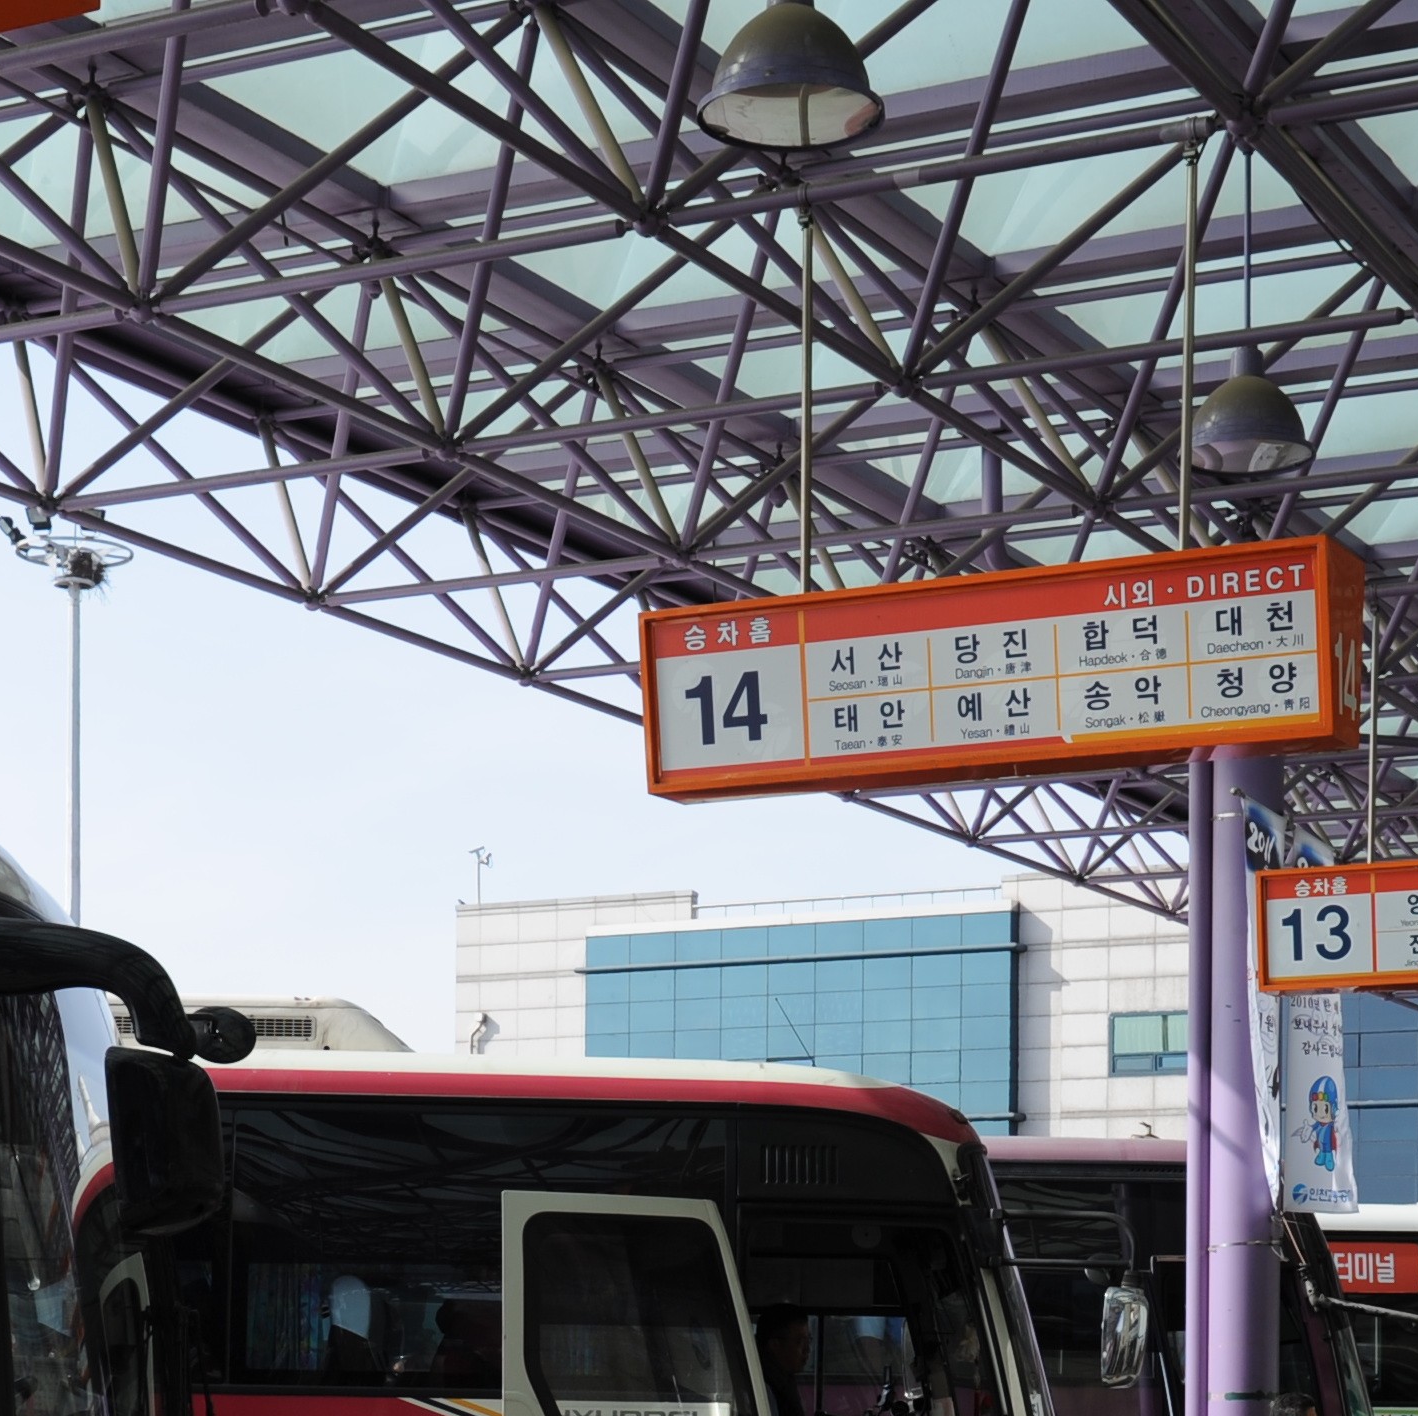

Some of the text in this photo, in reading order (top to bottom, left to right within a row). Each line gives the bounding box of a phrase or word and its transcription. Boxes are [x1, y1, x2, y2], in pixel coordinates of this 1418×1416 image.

[1103, 564, 1305, 608] 시외 DIRECT
[683, 616, 772, 651] 승차홈
[1083, 615, 1159, 651] 합덕
[1216, 600, 1294, 636] 대천
[831, 641, 903, 675] 서산
[954, 629, 1028, 664] 당진
[1078, 653, 1128, 669] Hapdeok
[1206, 634, 1305, 655] Daecheon 大川
[828, 678, 867, 691] Seosan
[954, 665, 994, 681] Dangjin
[1217, 661, 1297, 699] 청양
[684, 670, 768, 746] 14
[957, 687, 1031, 722] 예산
[1084, 675, 1161, 711] 송악
[833, 700, 906, 732] 태안
[1085, 714, 1127, 729] Songak
[1200, 701, 1271, 719] Cheongyang
[834, 738, 866, 751] Taean
[960, 726, 993, 740] Yesan
[1294, 876, 1348, 898] 승차홈
[1281, 904, 1353, 962] 13
[1334, 1252, 1395, 1284] 터미널
